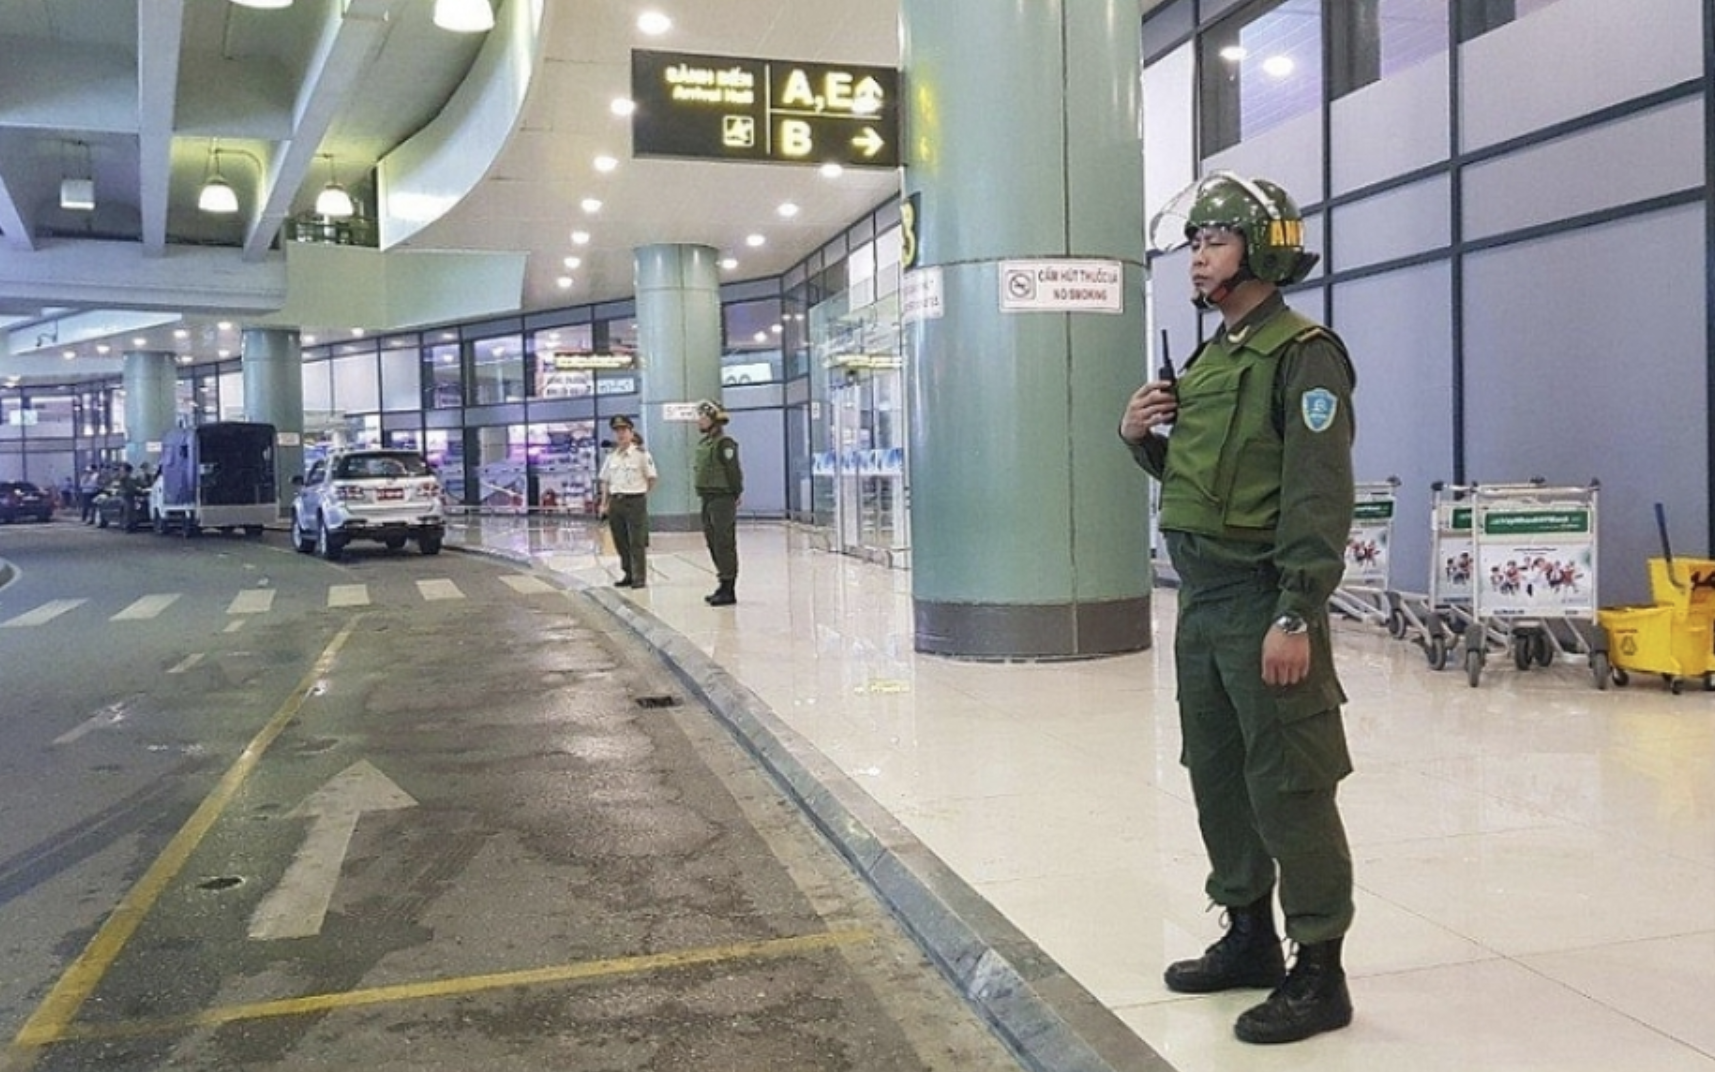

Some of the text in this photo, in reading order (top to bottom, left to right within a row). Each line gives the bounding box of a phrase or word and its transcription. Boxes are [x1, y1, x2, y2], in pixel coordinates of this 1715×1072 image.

[782, 119, 812, 156] B
[1053, 287, 1107, 301] NO SMOKING
